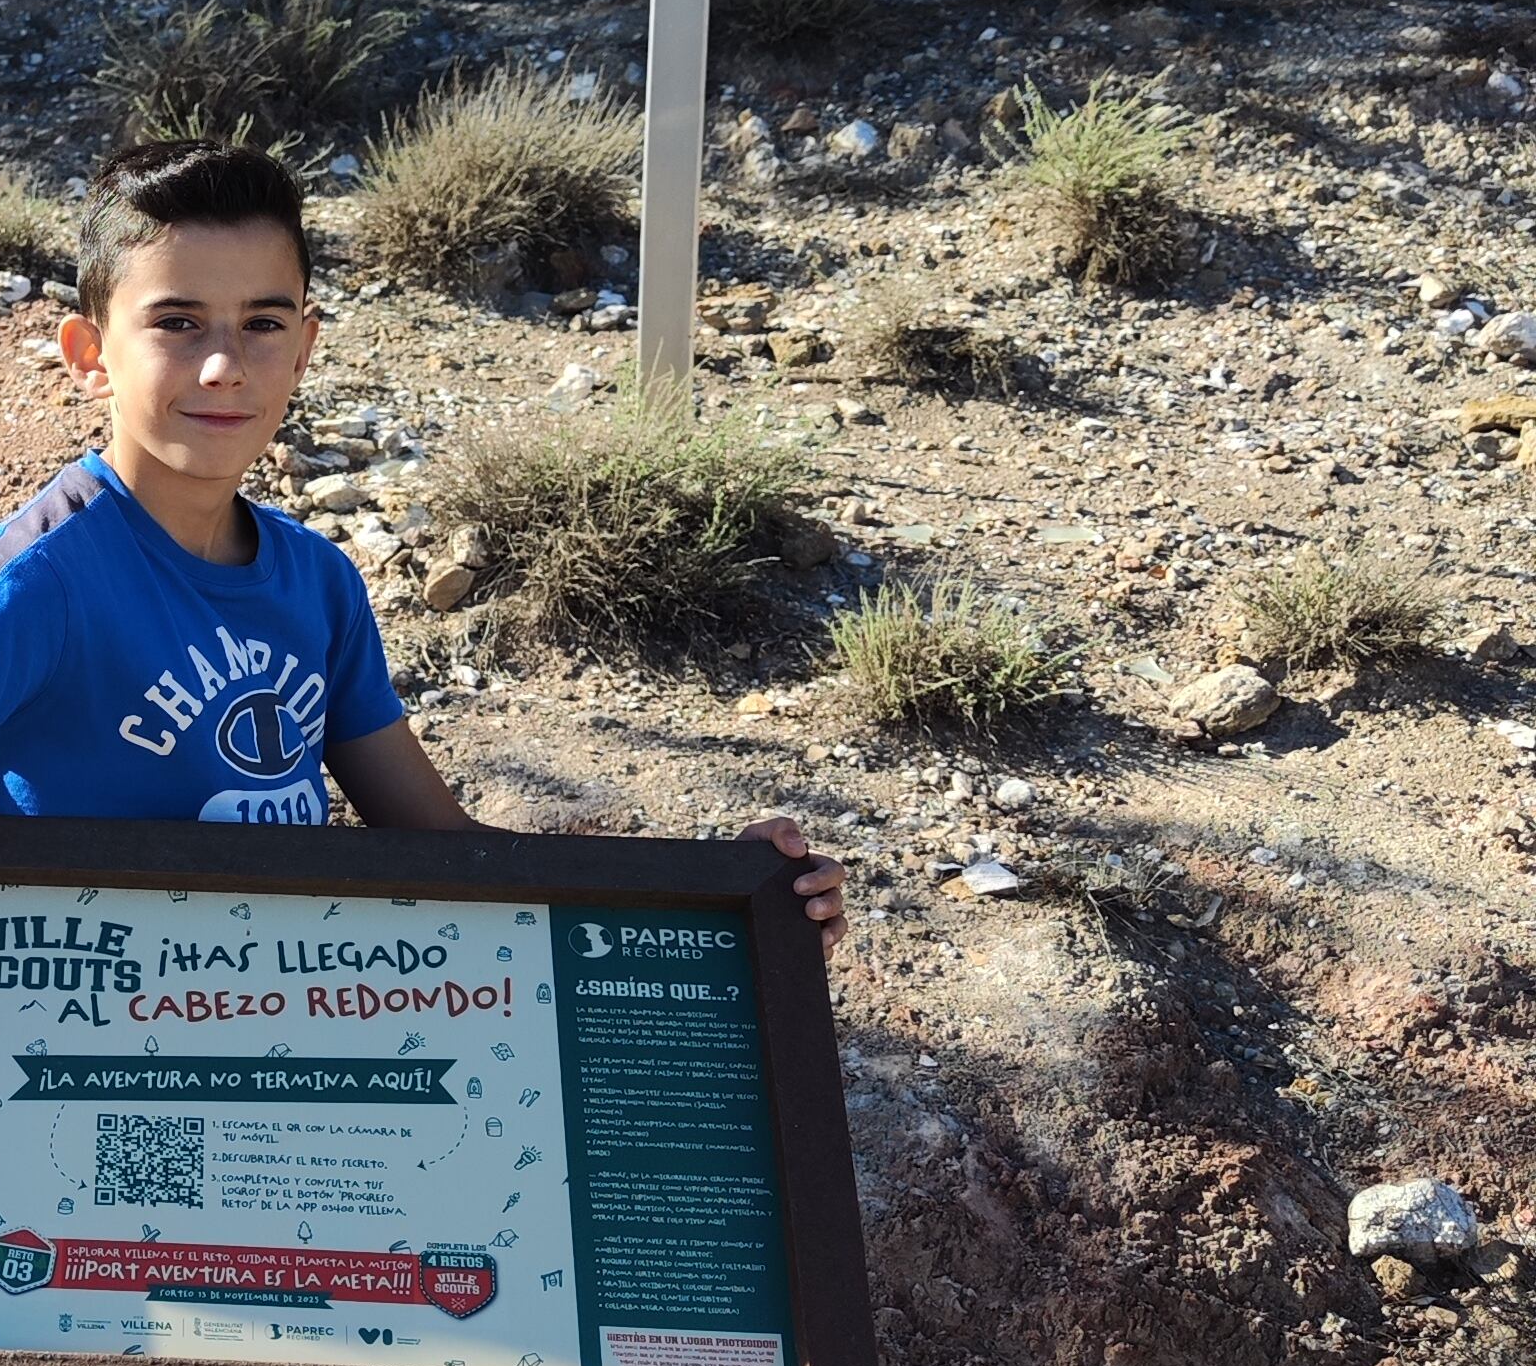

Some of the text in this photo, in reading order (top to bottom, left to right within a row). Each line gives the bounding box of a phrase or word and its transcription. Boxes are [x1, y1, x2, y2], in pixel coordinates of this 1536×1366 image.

[119, 626, 326, 755] CHAMPION
[620, 926, 736, 948] PAPREC
[159, 937, 447, 977] ¡HAS LLEGADO
[622, 947, 703, 960] RECIMED
[575, 976, 740, 1001] ¿SABÍAS QUE...?
[58, 977, 512, 1027] AL CABEZO REDONDO!
[38, 1066, 433, 1094] ¡LA AVENTURA NO TERMINA AQUÍ!
[222, 1120, 268, 1130] ESCANEA
[272, 1122, 282, 1131] EL
[286, 1123, 301, 1133] QR
[305, 1124, 325, 1132] CON
[329, 1125, 344, 1134] LA
[348, 1126, 397, 1136] CÁMARA
[400, 1127, 412, 1137] DE
[222, 1132, 236, 1142] TU
[296, 1156, 307, 1165] EL
[310, 1156, 337, 1167] RETO
[342, 1158, 388, 1169] SECRETO.
[294, 1177, 301, 1186] Y
[305, 1178, 359, 1188] CONSULTA
[364, 1180, 384, 1190] TUS
[222, 1186, 261, 1197] LOGROS
[266, 1189, 278, 1197] EN
[283, 1189, 293, 1198] EL
[297, 1189, 334, 1200] BOTÓN
[261, 1200, 272, 1210] DE
[277, 1201, 290, 1211] LA
[295, 1202, 317, 1212] APP
[321, 1204, 354, 1213] 03400
[359, 1205, 407, 1216] VILLENA.
[426, 1242, 487, 1252] COMPLETA LOS
[7, 1248, 34, 1261] RETO
[124, 1248, 170, 1260] VILLENA
[173, 1251, 185, 1260] ES
[188, 1251, 199, 1261] EL
[203, 1252, 234, 1265] RETO,
[237, 1253, 277, 1265] CUIDAR
[280, 1255, 292, 1266] EL
[295, 1256, 346, 1268] PLANETA
[349, 1258, 365, 1269] LA
[368, 1260, 413, 1271] MISIÓN
[427, 1255, 484, 1268] 4 RETOS
[2, 1258, 34, 1282] 03
[145, 1264, 256, 1285] AVENTURA
[264, 1269, 286, 1286] ES
[294, 1269, 321, 1288] LA
[330, 1272, 412, 1295] META!!!
[436, 1272, 477, 1285] VILLE
[159, 1288, 194, 1298] SORTEO
[210, 1291, 220, 1300] DE
[224, 1292, 279, 1302] NOVIEMBRE
[283, 1294, 293, 1303] DE
[297, 1295, 319, 1304] 2025
[434, 1283, 480, 1295] SCOUTS
[120, 1319, 173, 1331] VILLENA
[286, 1325, 334, 1336] PAPREC
[649, 1335, 662, 1344] EN
[665, 1336, 678, 1345] UN
[681, 1336, 713, 1346] LUGAR
